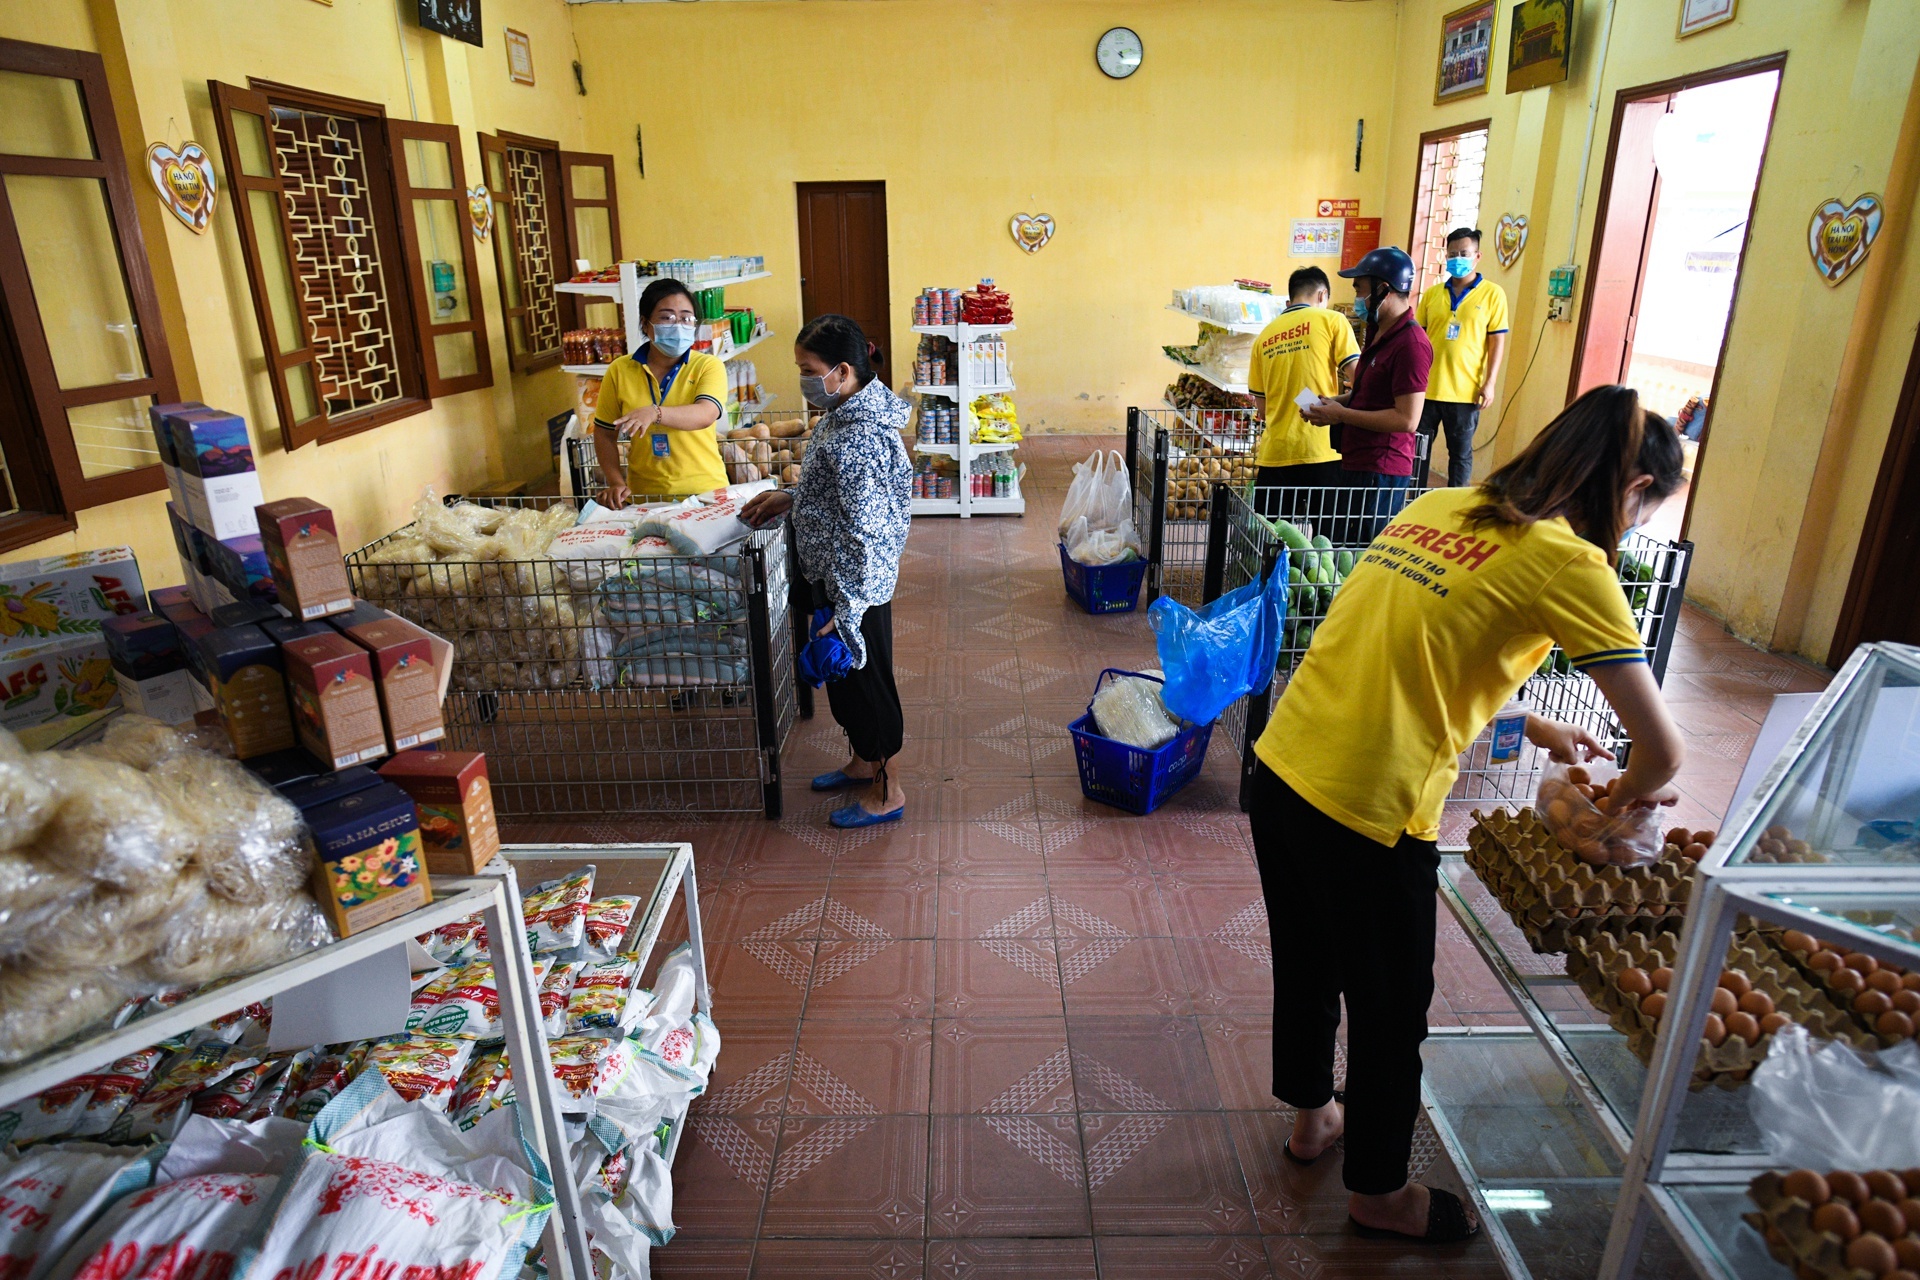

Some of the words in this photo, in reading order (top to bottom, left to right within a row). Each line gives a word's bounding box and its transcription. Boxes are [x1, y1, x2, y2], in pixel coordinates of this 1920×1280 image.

[1262, 321, 1310, 349] REFRESH
[1380, 523, 1502, 572] REFRESH
[1406, 552, 1424, 565] TÁI
[1423, 561, 1447, 577] TẠO
[1429, 582, 1450, 598] XA
